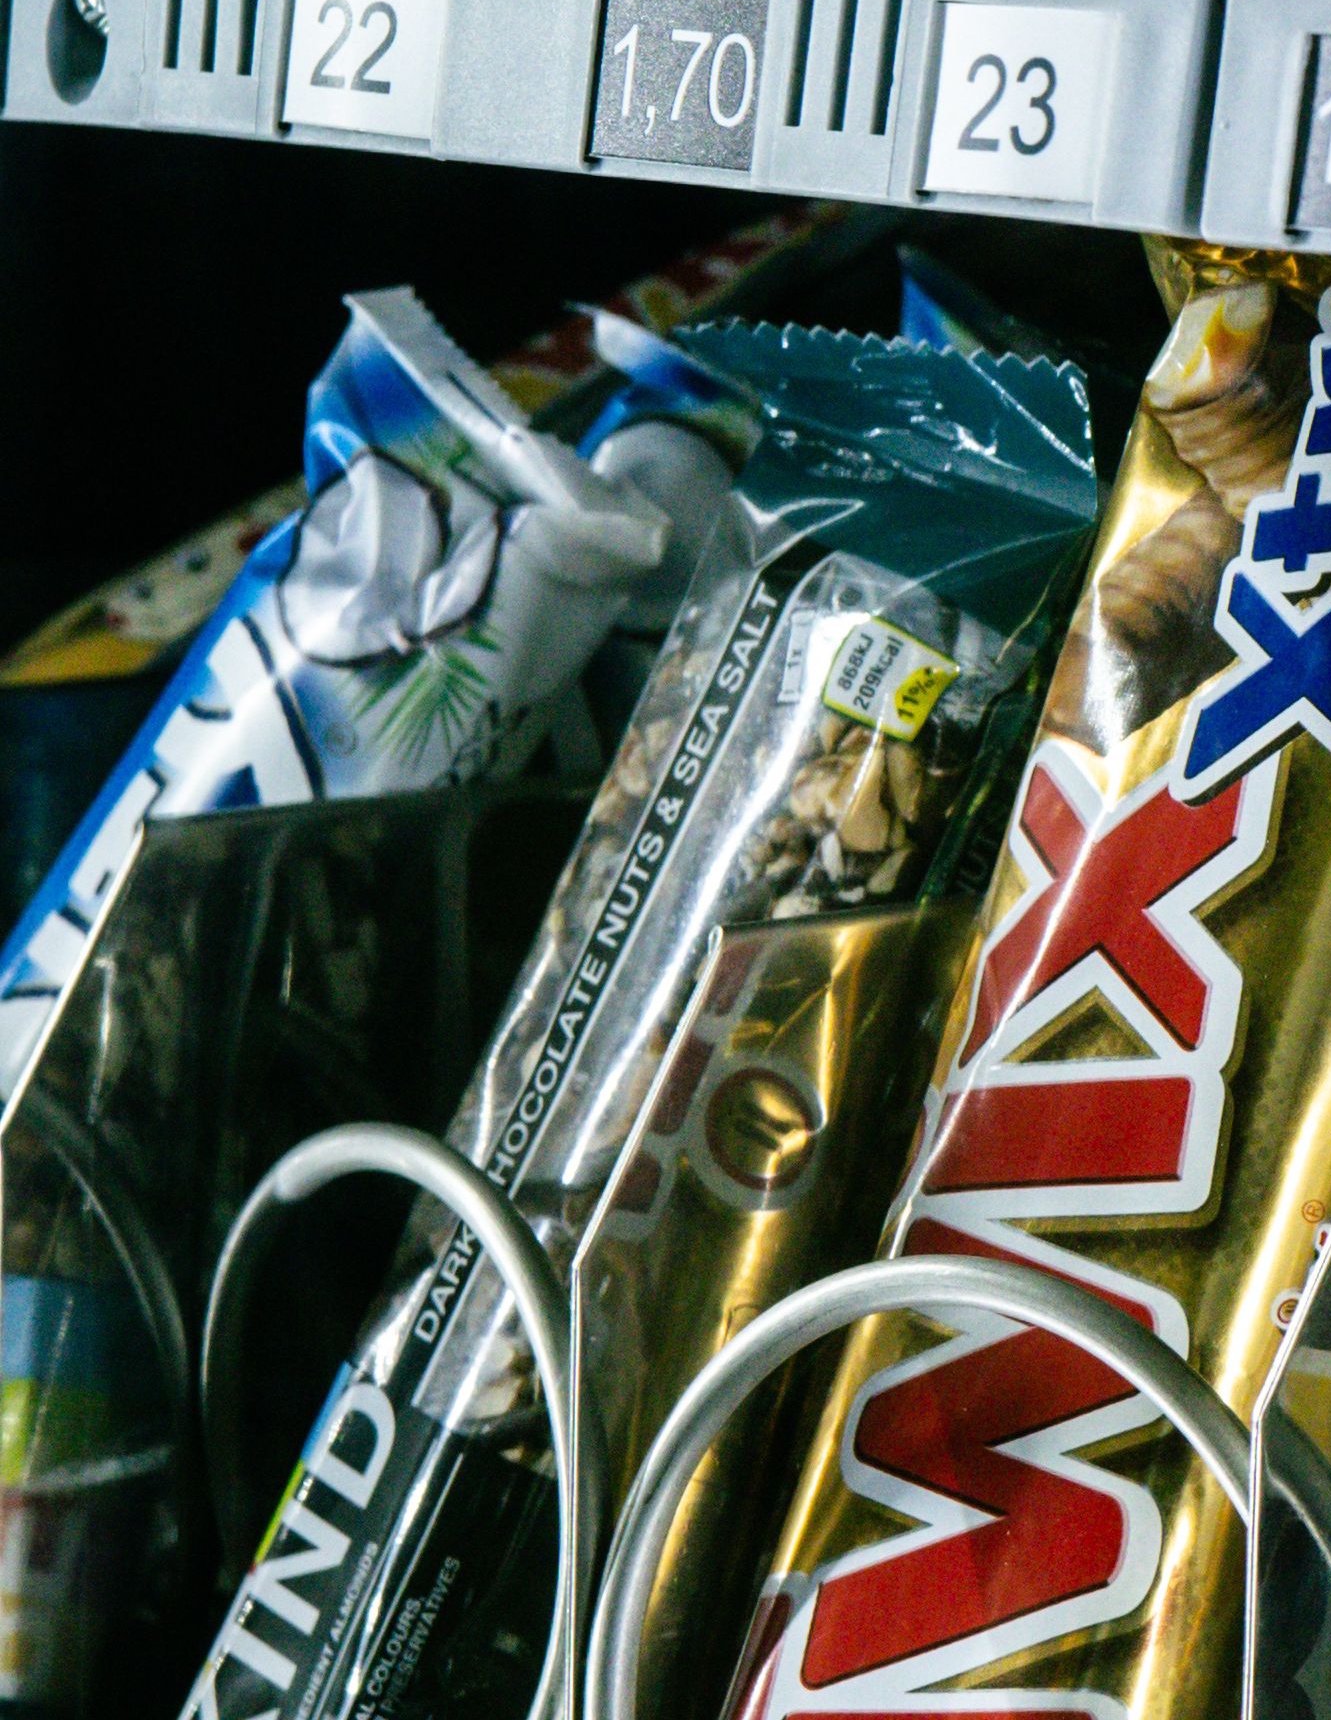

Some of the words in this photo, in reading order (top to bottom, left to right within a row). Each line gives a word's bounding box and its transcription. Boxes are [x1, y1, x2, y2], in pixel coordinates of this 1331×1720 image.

[614, 23, 755, 137] 1,70
[957, 53, 1059, 158] 23
[837, 632, 874, 692] 868kJ
[852, 635, 904, 711] 209kcal
[415, 1221, 485, 1344] DARK
[488, 950, 609, 1187] HOCOLATE
[601, 827, 667, 951] NUTS
[656, 792, 683, 826] &
[675, 700, 730, 786] SEA
[717, 582, 780, 699] SALT
[725, 745, 1262, 1720] WIX
